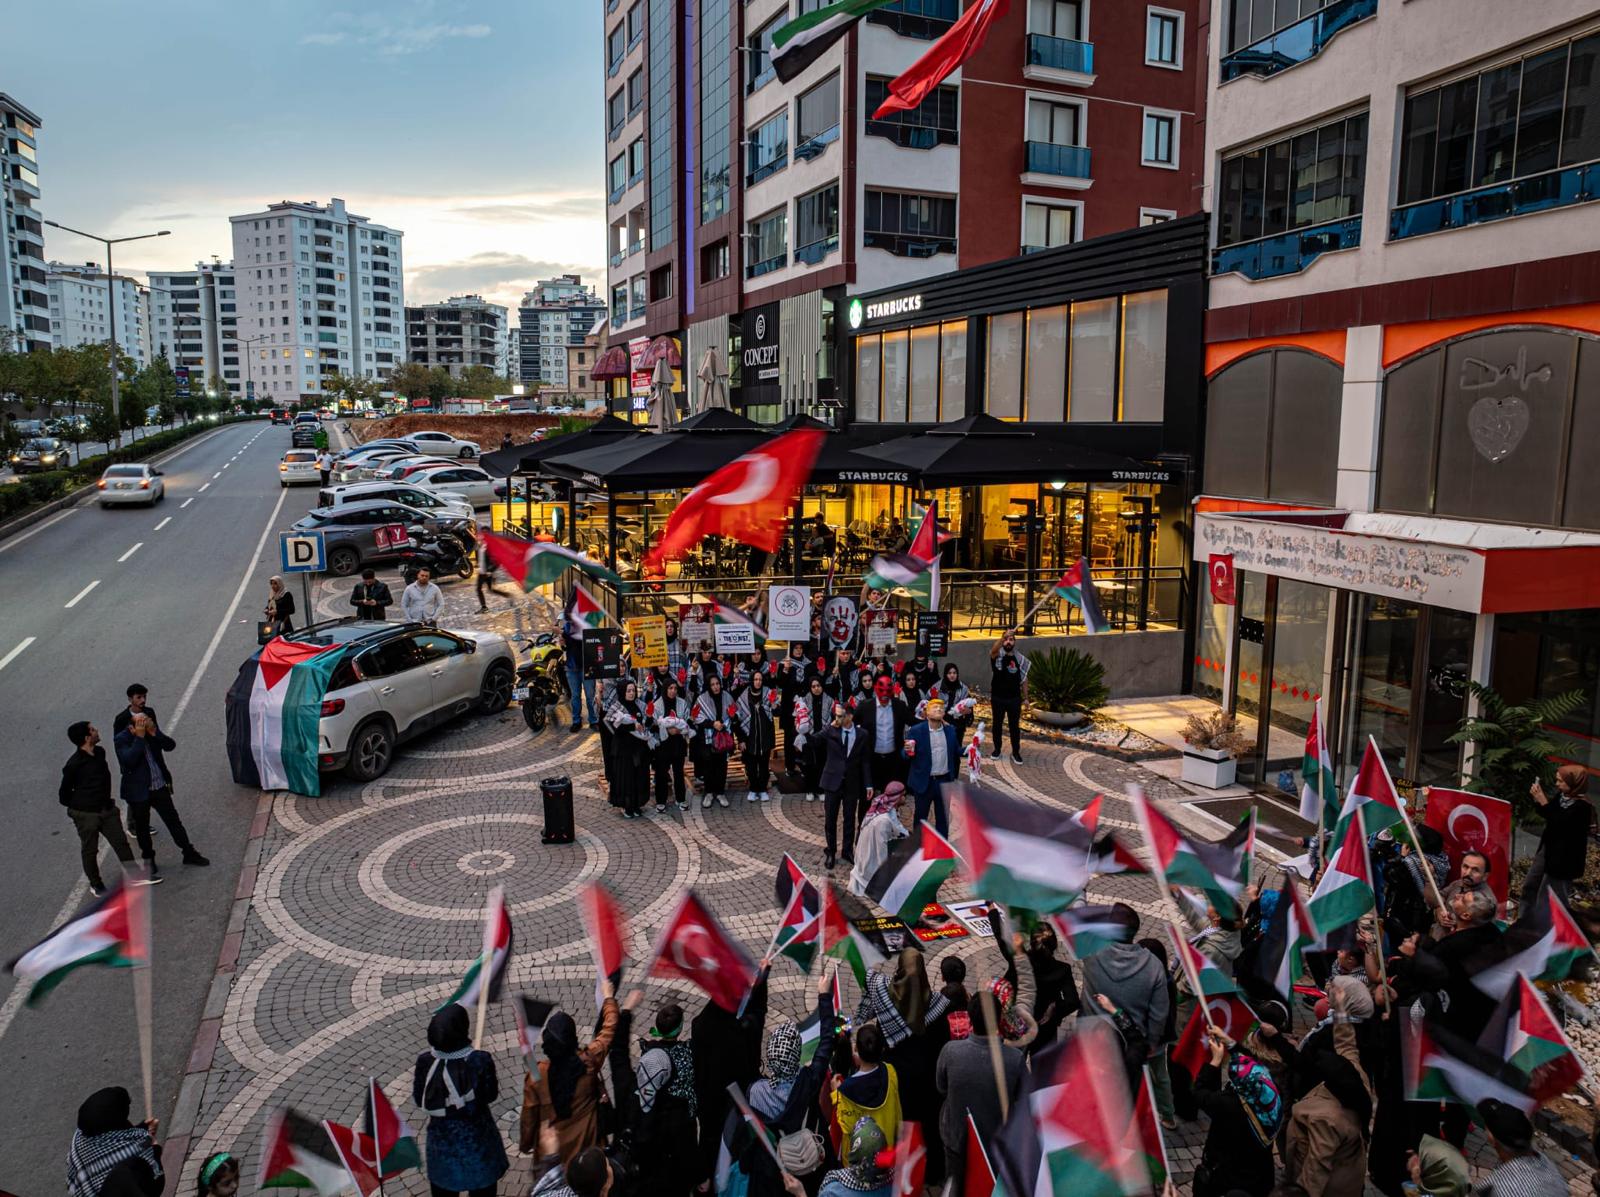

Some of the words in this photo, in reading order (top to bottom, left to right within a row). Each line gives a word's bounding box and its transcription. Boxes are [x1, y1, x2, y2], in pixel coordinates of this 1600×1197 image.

[867, 295, 921, 319] STARBUCKS
[744, 345, 778, 366] CONCEPT
[838, 471, 908, 481] STARBUCKS
[1111, 471, 1170, 480] STARBUCKS
[394, 528, 401, 540] Y
[293, 540, 314, 563] D
